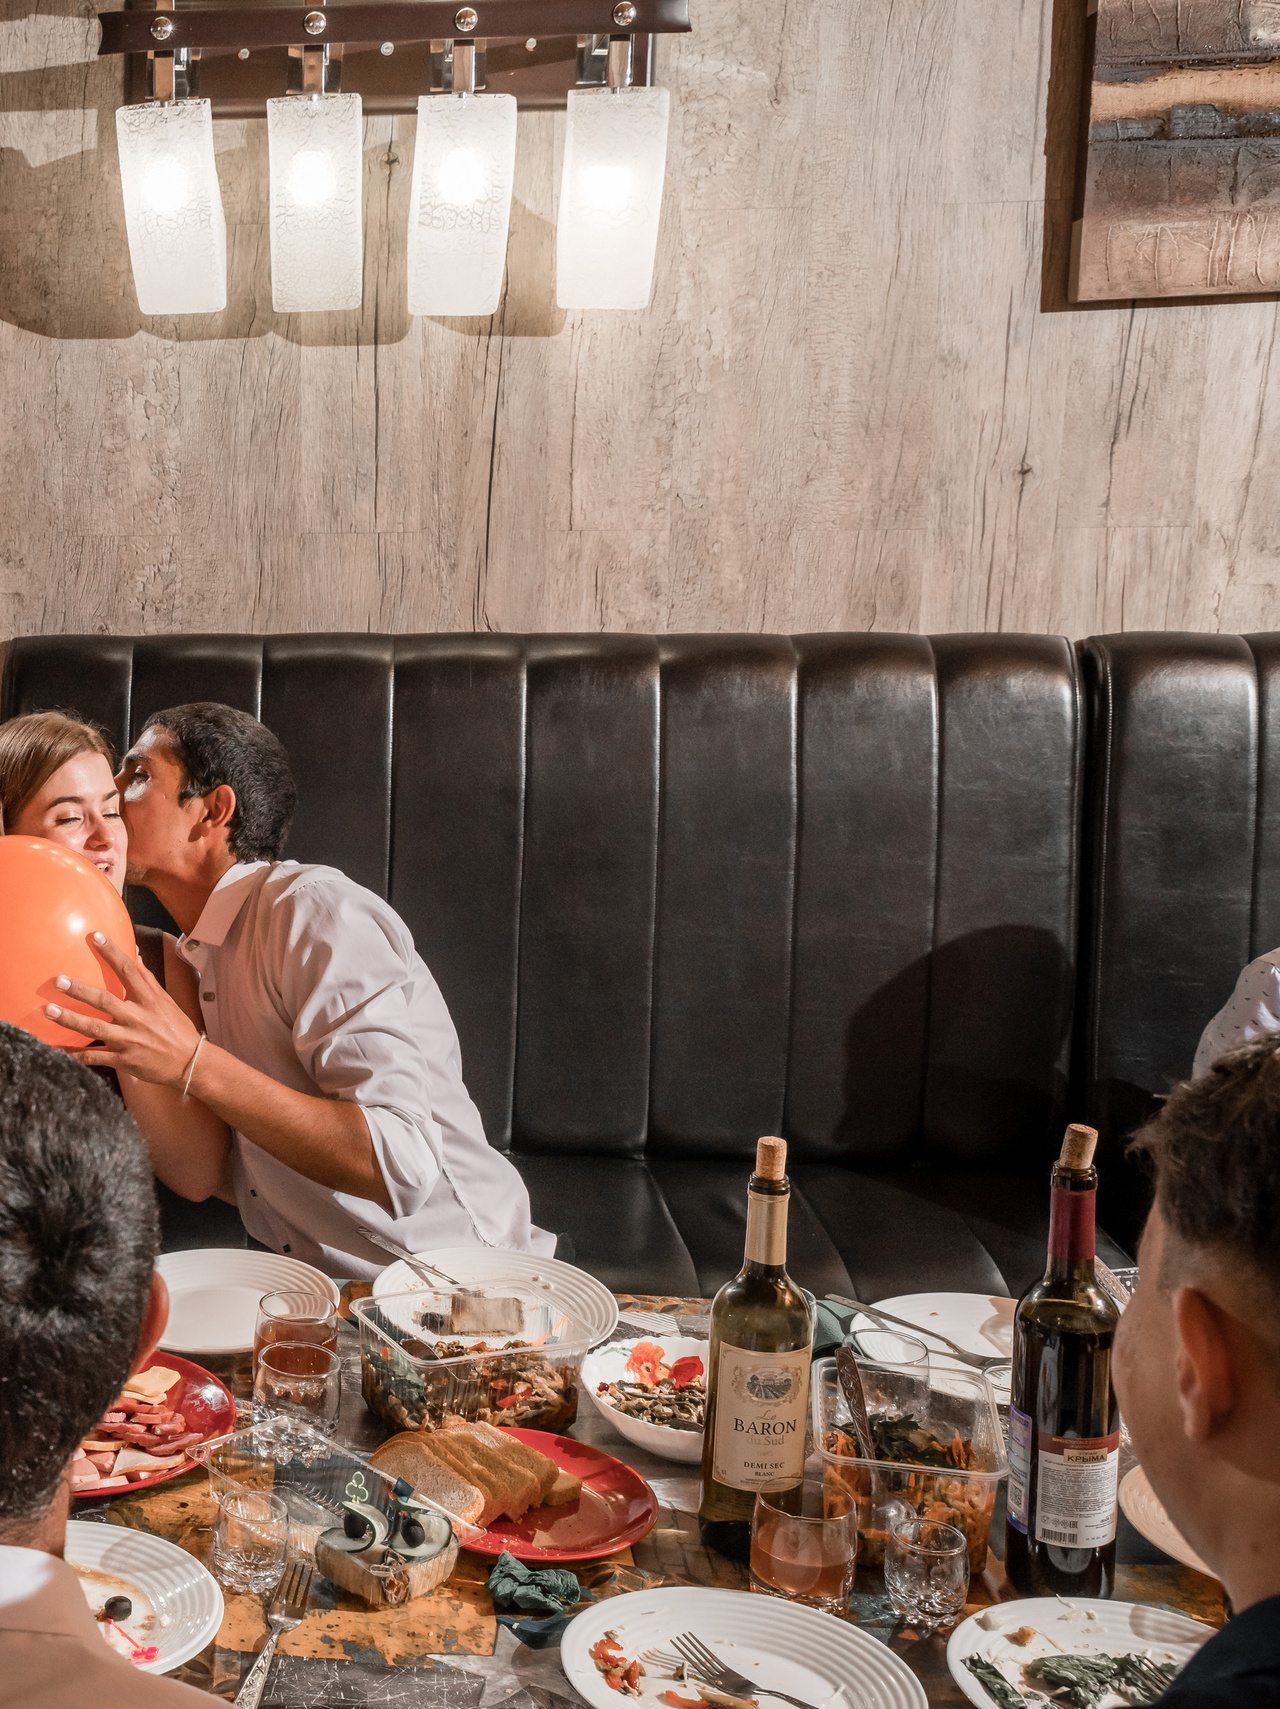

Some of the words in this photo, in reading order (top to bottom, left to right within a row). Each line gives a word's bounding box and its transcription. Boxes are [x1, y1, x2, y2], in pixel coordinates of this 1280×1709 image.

[756, 1410, 777, 1420] Le
[734, 1418, 797, 1435] BARON
[747, 1435, 761, 1445] du
[764, 1435, 785, 1445] Sud
[744, 1461, 767, 1469] DEMI
